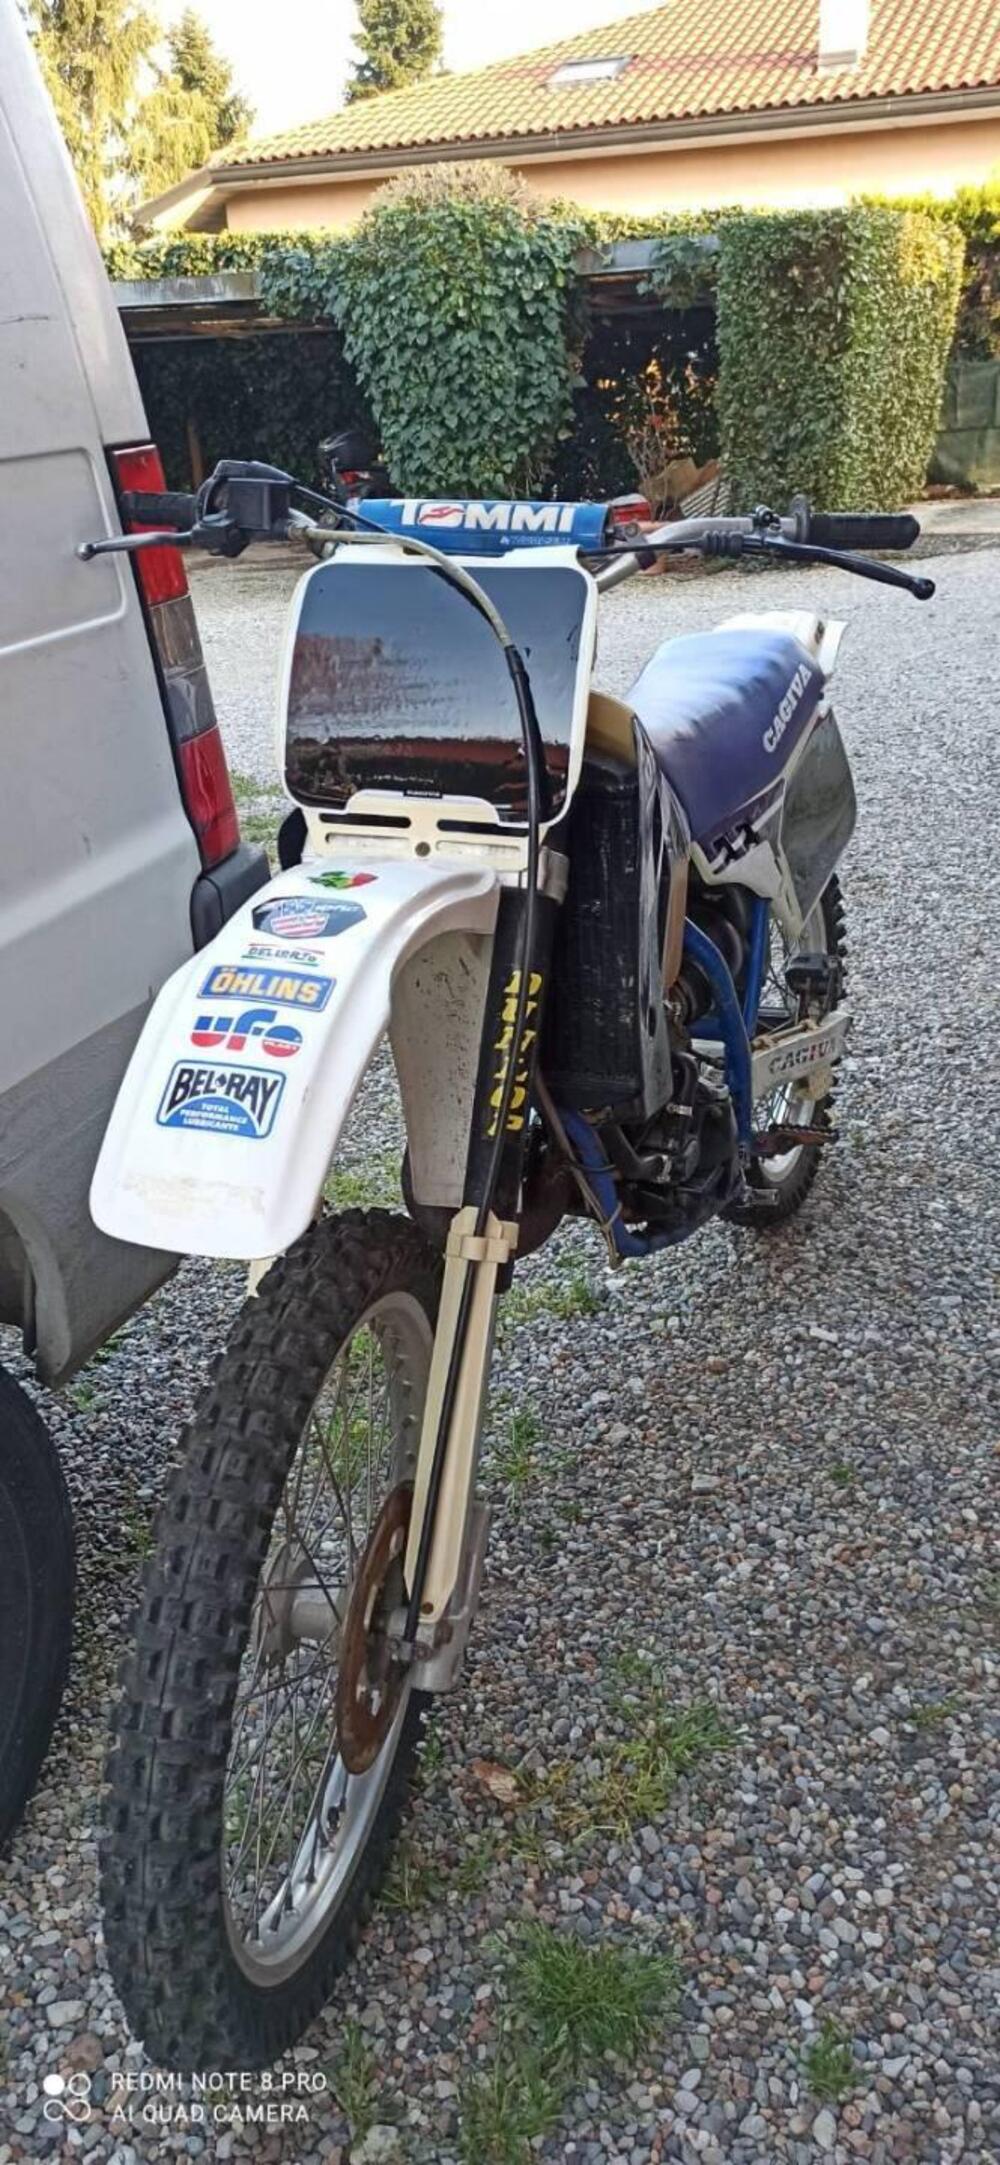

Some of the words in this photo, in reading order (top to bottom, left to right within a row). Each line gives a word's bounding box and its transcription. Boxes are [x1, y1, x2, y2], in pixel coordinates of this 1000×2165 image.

[390, 500, 576, 532] TOMMI
[762, 664, 812, 752] CAGIVA
[210, 967, 322, 1004] ÖHLINS
[201, 1102, 230, 1114] TOTAL
